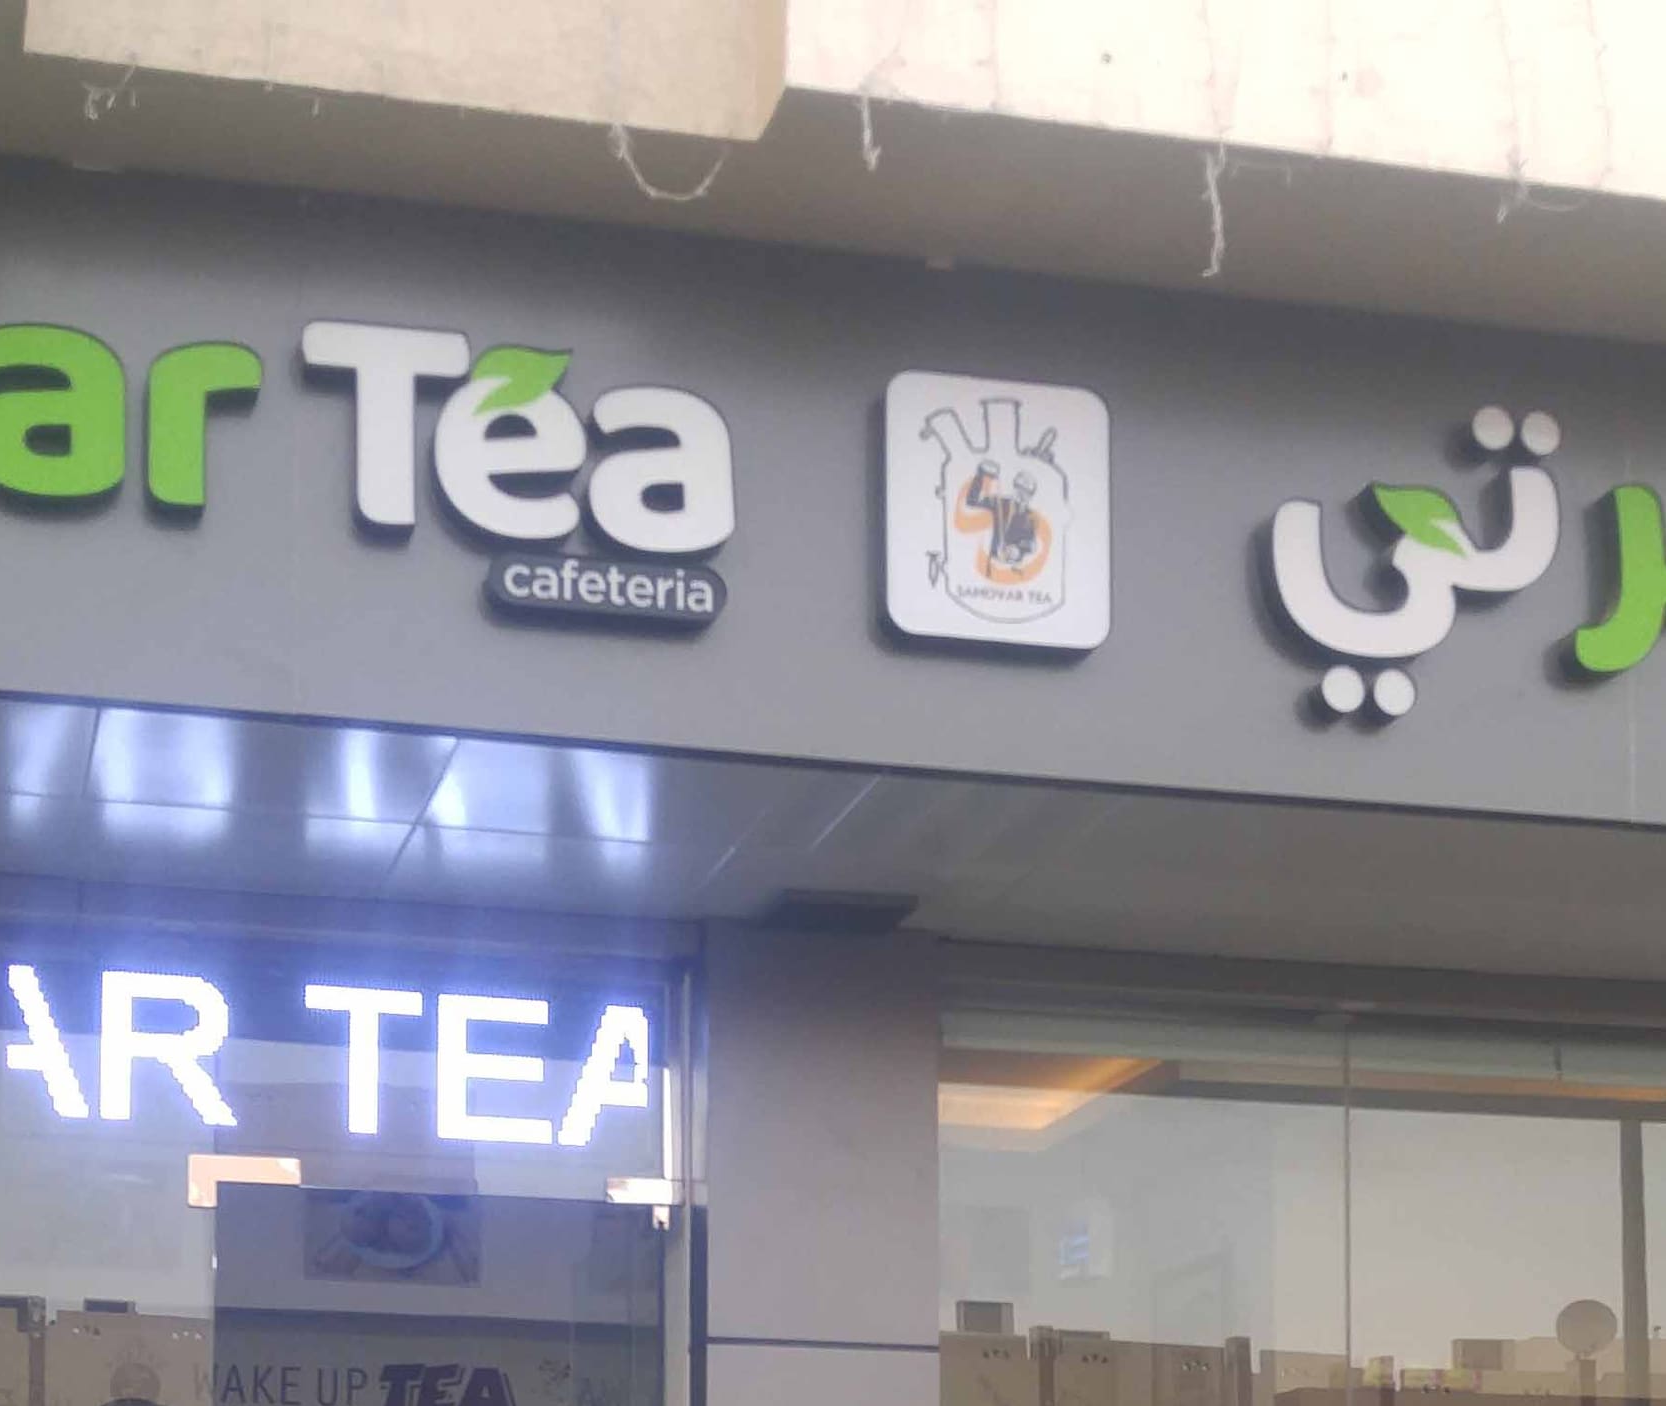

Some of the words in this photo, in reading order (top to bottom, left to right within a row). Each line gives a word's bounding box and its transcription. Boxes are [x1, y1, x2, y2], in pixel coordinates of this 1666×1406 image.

[300, 319, 736, 553] Tea
[503, 558, 714, 613] cafeteria
[957, 584, 1024, 602] SAMOVAR
[1028, 590, 1052, 605] TEA
[1271, 405, 1561, 718] تي
[305, 983, 649, 1147] TEA
[193, 1363, 302, 1406] WAKE
